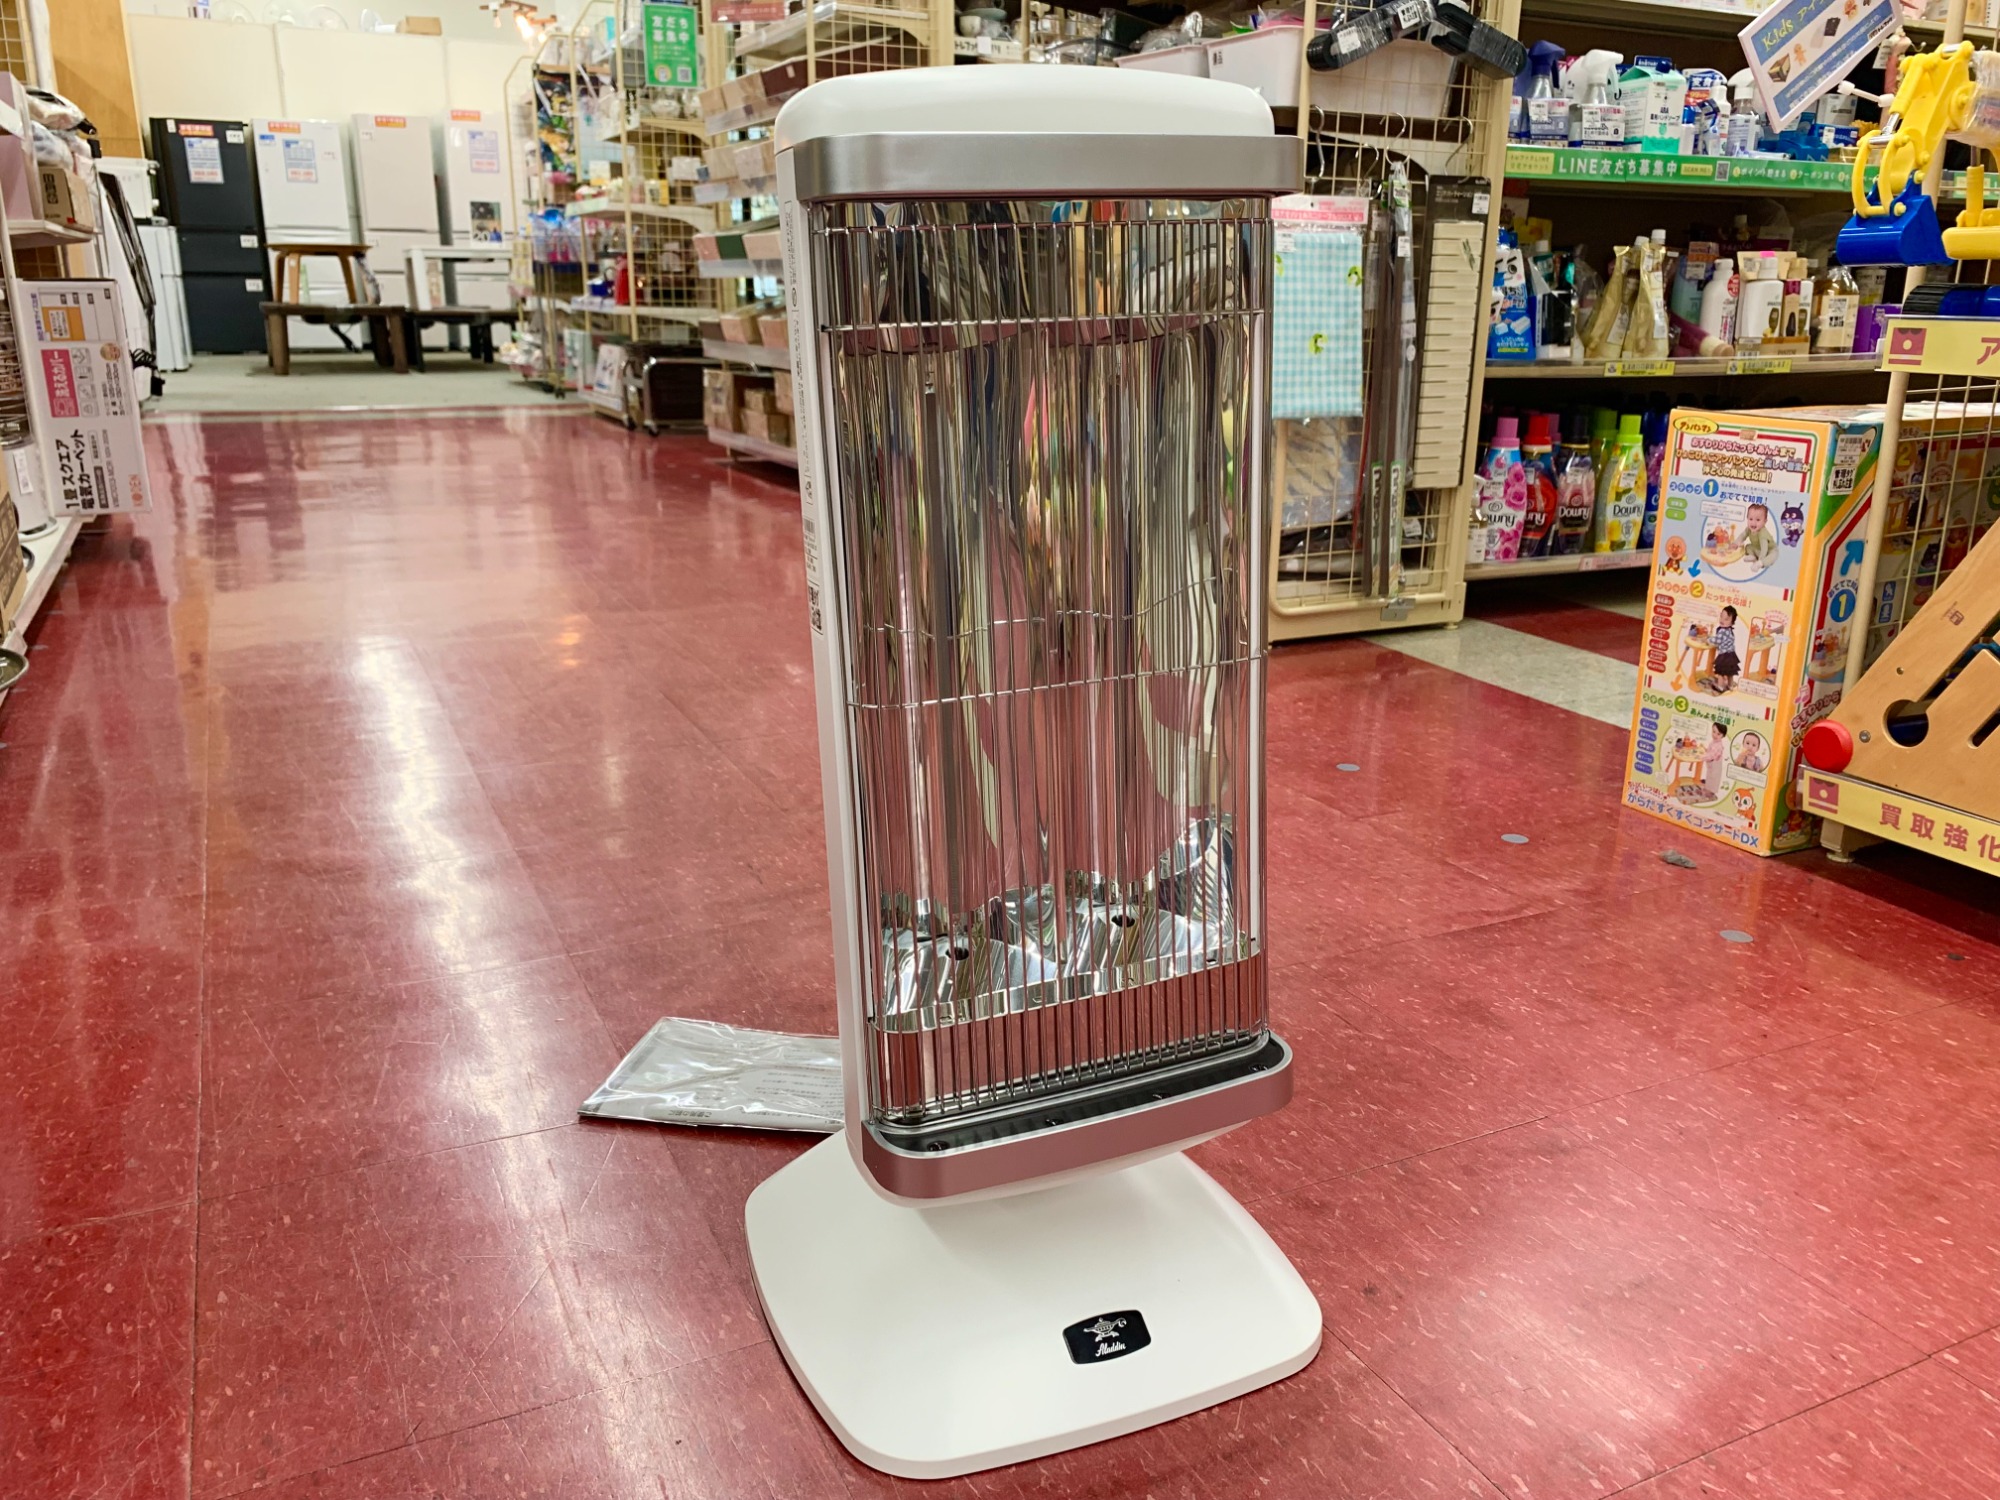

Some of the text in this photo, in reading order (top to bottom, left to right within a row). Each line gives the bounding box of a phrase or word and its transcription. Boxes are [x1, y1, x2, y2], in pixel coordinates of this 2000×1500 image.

[651, 15, 689, 29] 友だち
[1761, 18, 1795, 52] Kids
[1558, 156, 1678, 177] LINE友だち募集中
[51, 350, 70, 398] 洗えるカバー
[55, 439, 80, 510] 1畳 スクエア
[70, 429, 95, 510] 電気カーペット
[1559, 506, 1590, 519] Downy
[1612, 504, 1643, 518] Downy
[1627, 793, 1759, 848] からだすくすくコンサートDX
[1879, 802, 2000, 863] 買取強化
[1095, 1341, 1126, 1357] Aladdin
